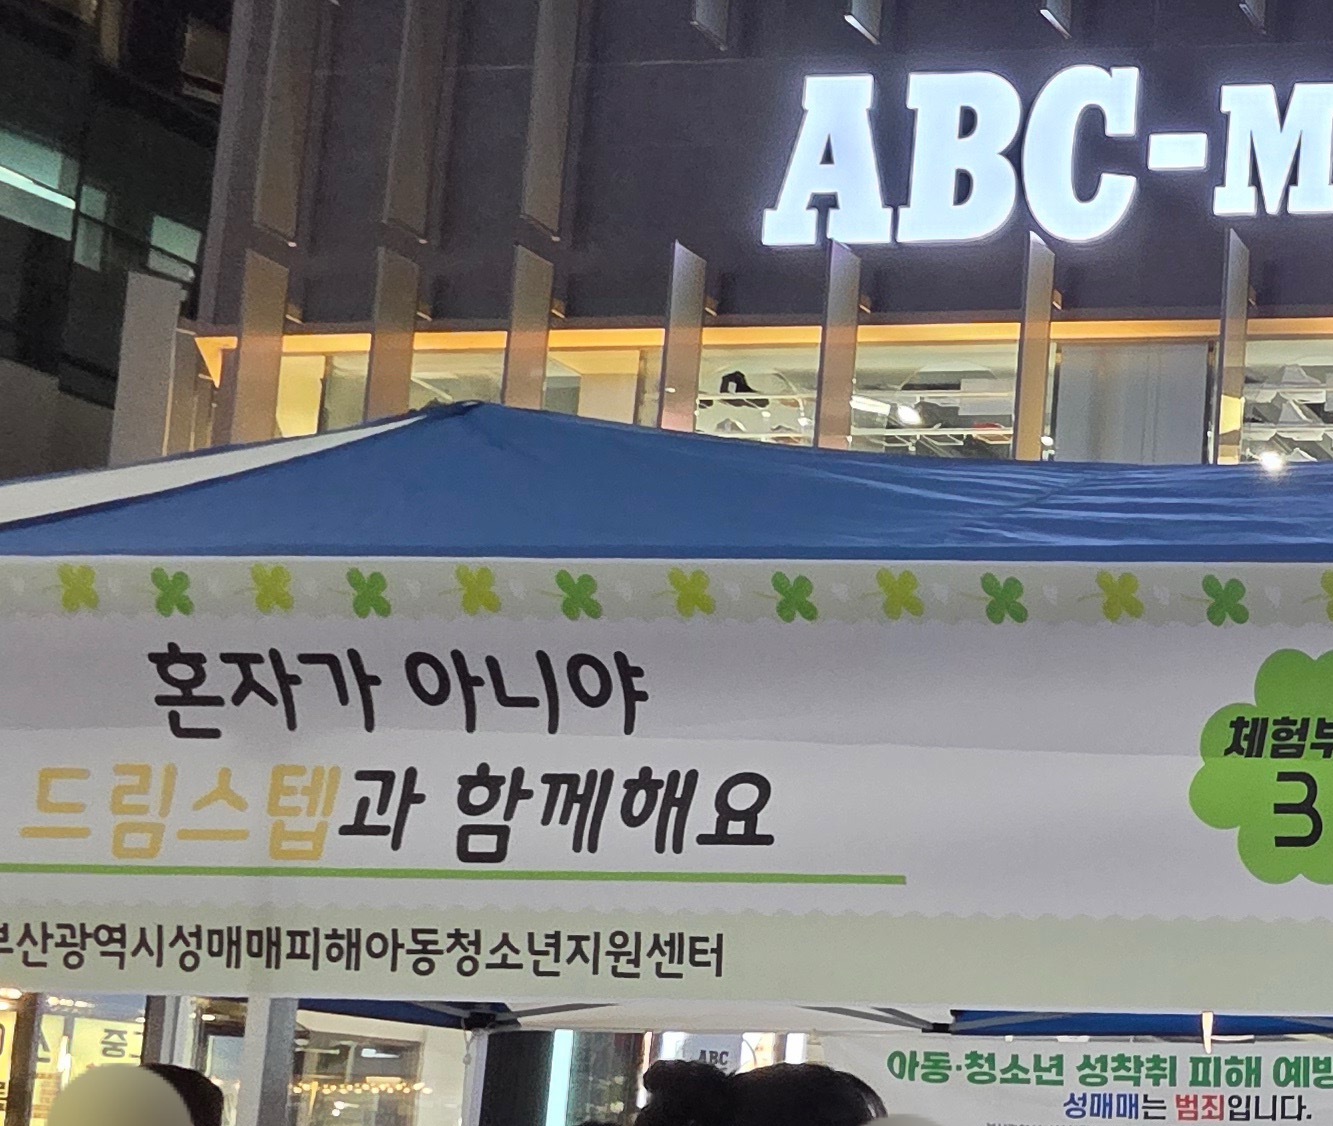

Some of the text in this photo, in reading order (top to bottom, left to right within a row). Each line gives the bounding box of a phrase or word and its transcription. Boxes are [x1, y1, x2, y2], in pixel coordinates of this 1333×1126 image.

[148, 642, 649, 739] 혼자가 아니야
[17, 762, 776, 864] 드림스텝과 함께해요
[1273, 771, 1323, 848] 3
[887, 1050, 1064, 1086] 아동·청소년
[1076, 1054, 1177, 1088] 성착취
[1188, 1056, 1262, 1089] 피해
[1062, 1092, 1313, 1122] 성매매는 범죄입니다.
